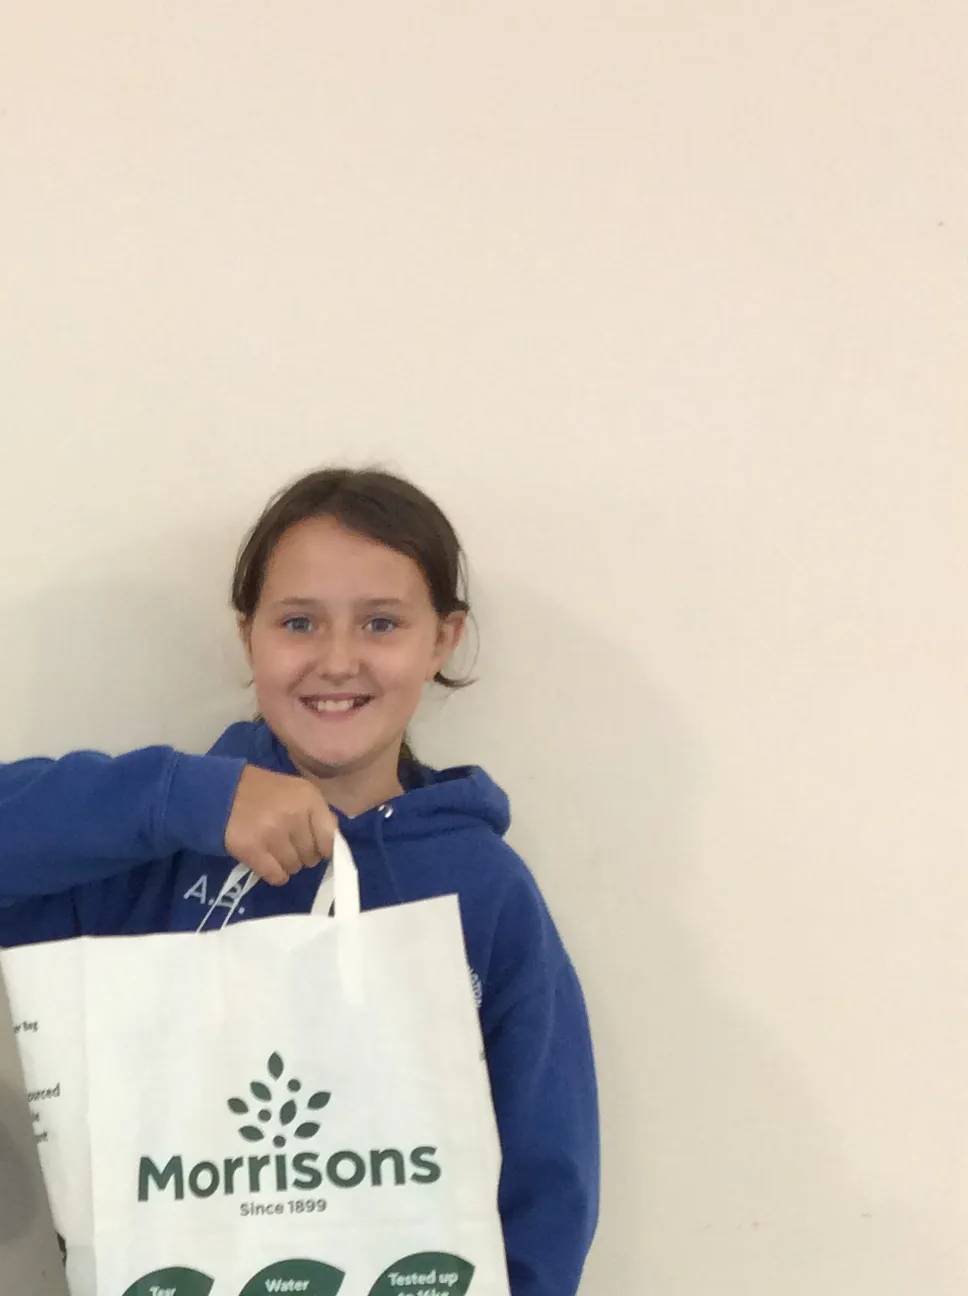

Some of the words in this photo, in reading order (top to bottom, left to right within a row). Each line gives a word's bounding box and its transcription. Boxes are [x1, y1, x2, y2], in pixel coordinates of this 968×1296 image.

[137, 1144, 442, 1203] Morrisons
[239, 1201, 284, 1217] Since
[287, 1198, 328, 1214] 1899
[264, 1278, 311, 1293] Water
[387, 1269, 436, 1287] Tested
[438, 1272, 459, 1287] up
